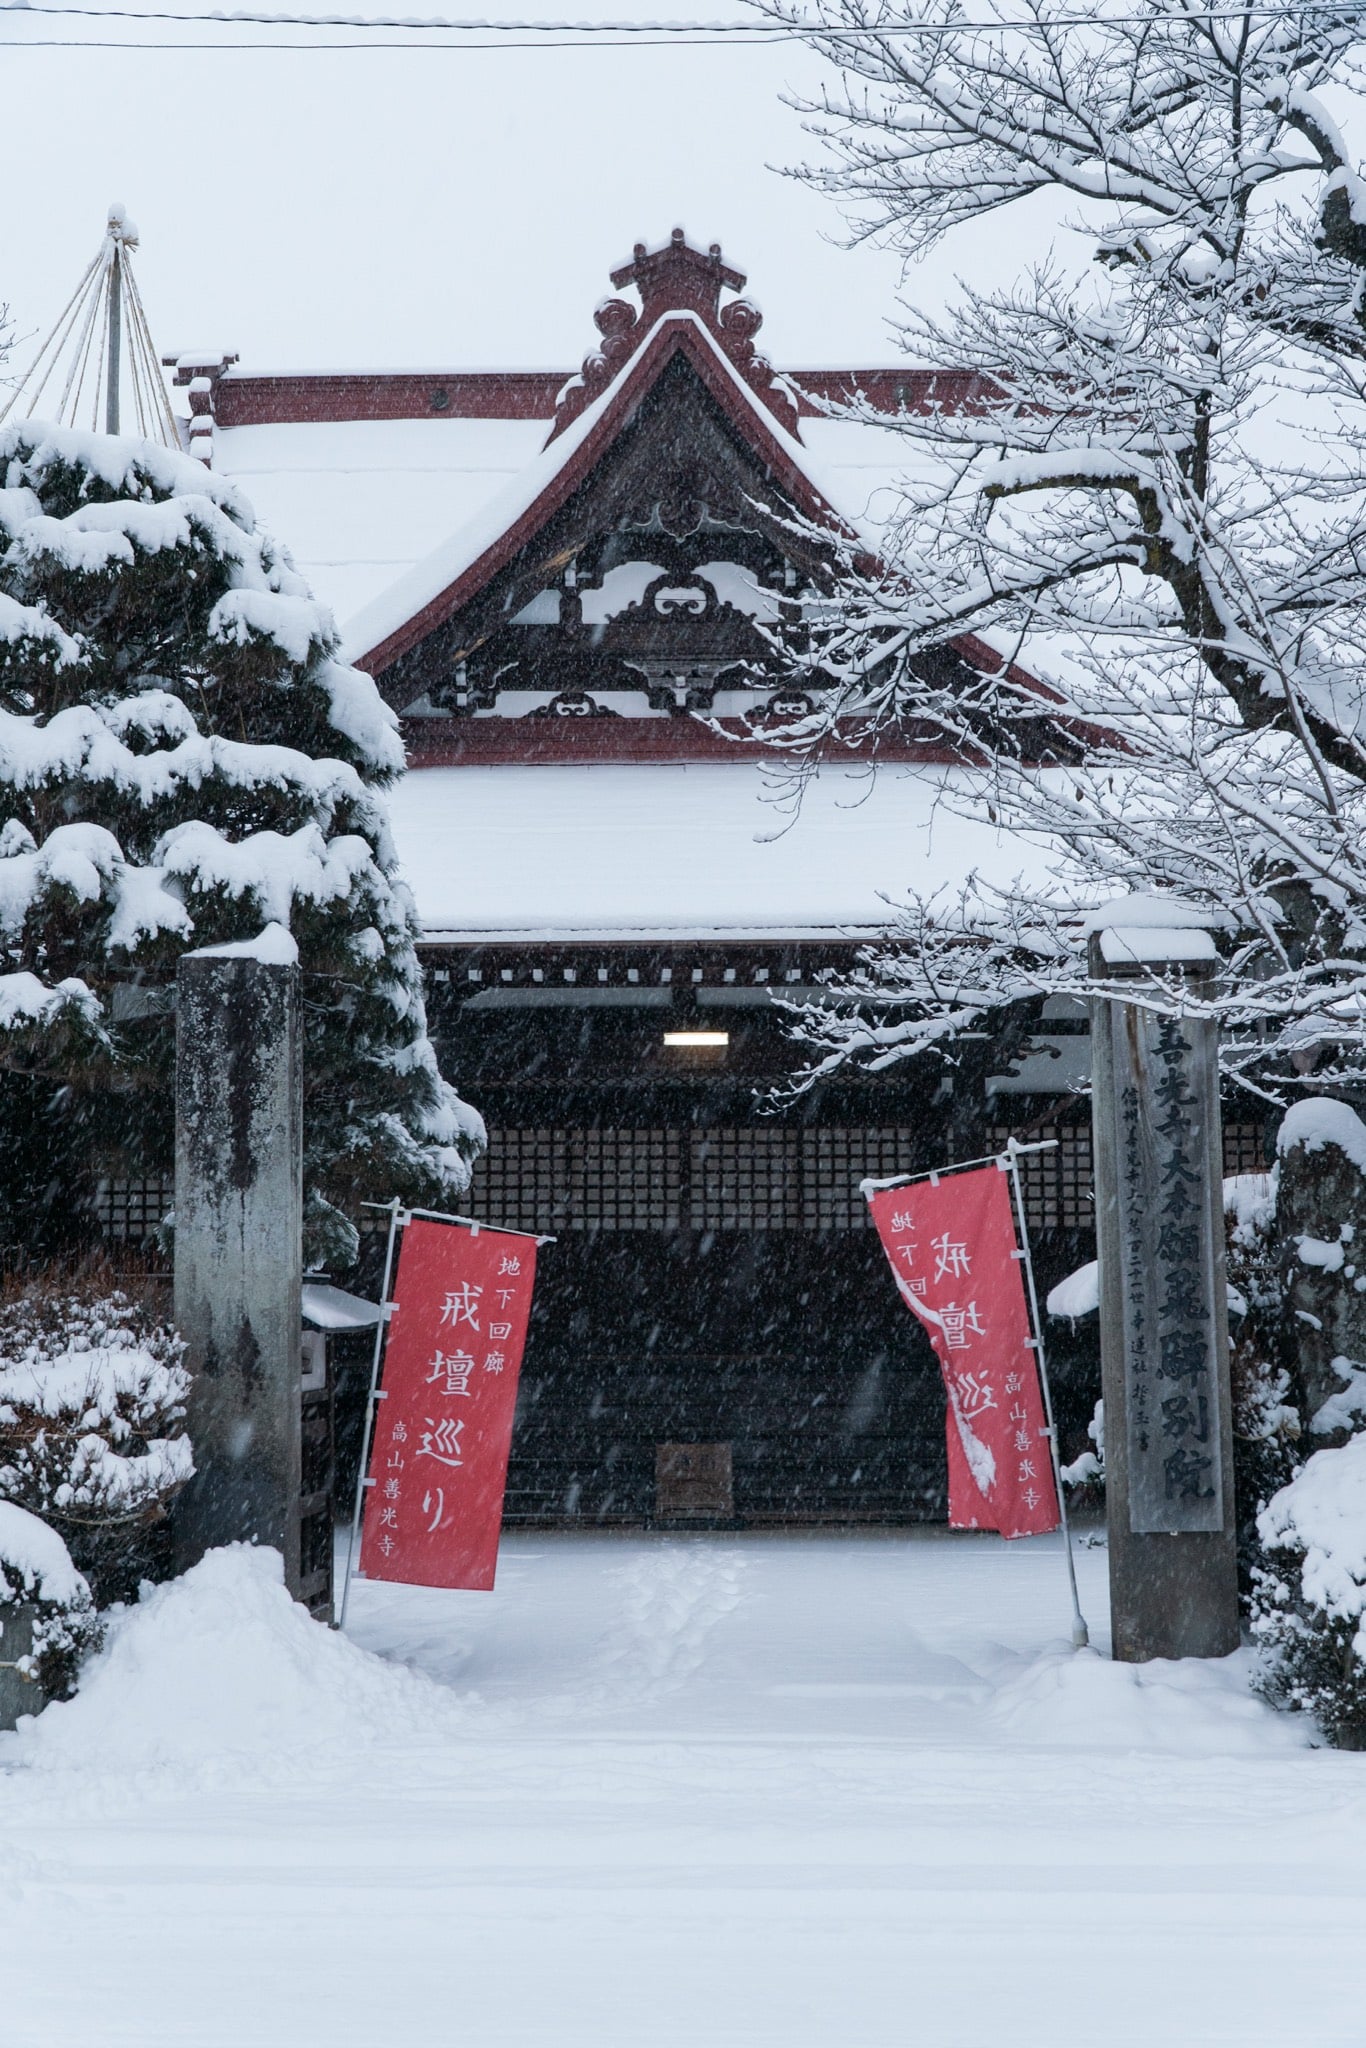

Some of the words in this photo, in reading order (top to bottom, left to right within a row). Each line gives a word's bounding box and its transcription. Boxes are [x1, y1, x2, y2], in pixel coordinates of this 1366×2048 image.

[482, 1256, 521, 1373] 地下回廊
[415, 1281, 484, 1532] 戒壇巡り
[377, 1421, 407, 1556] 高山善光寺
